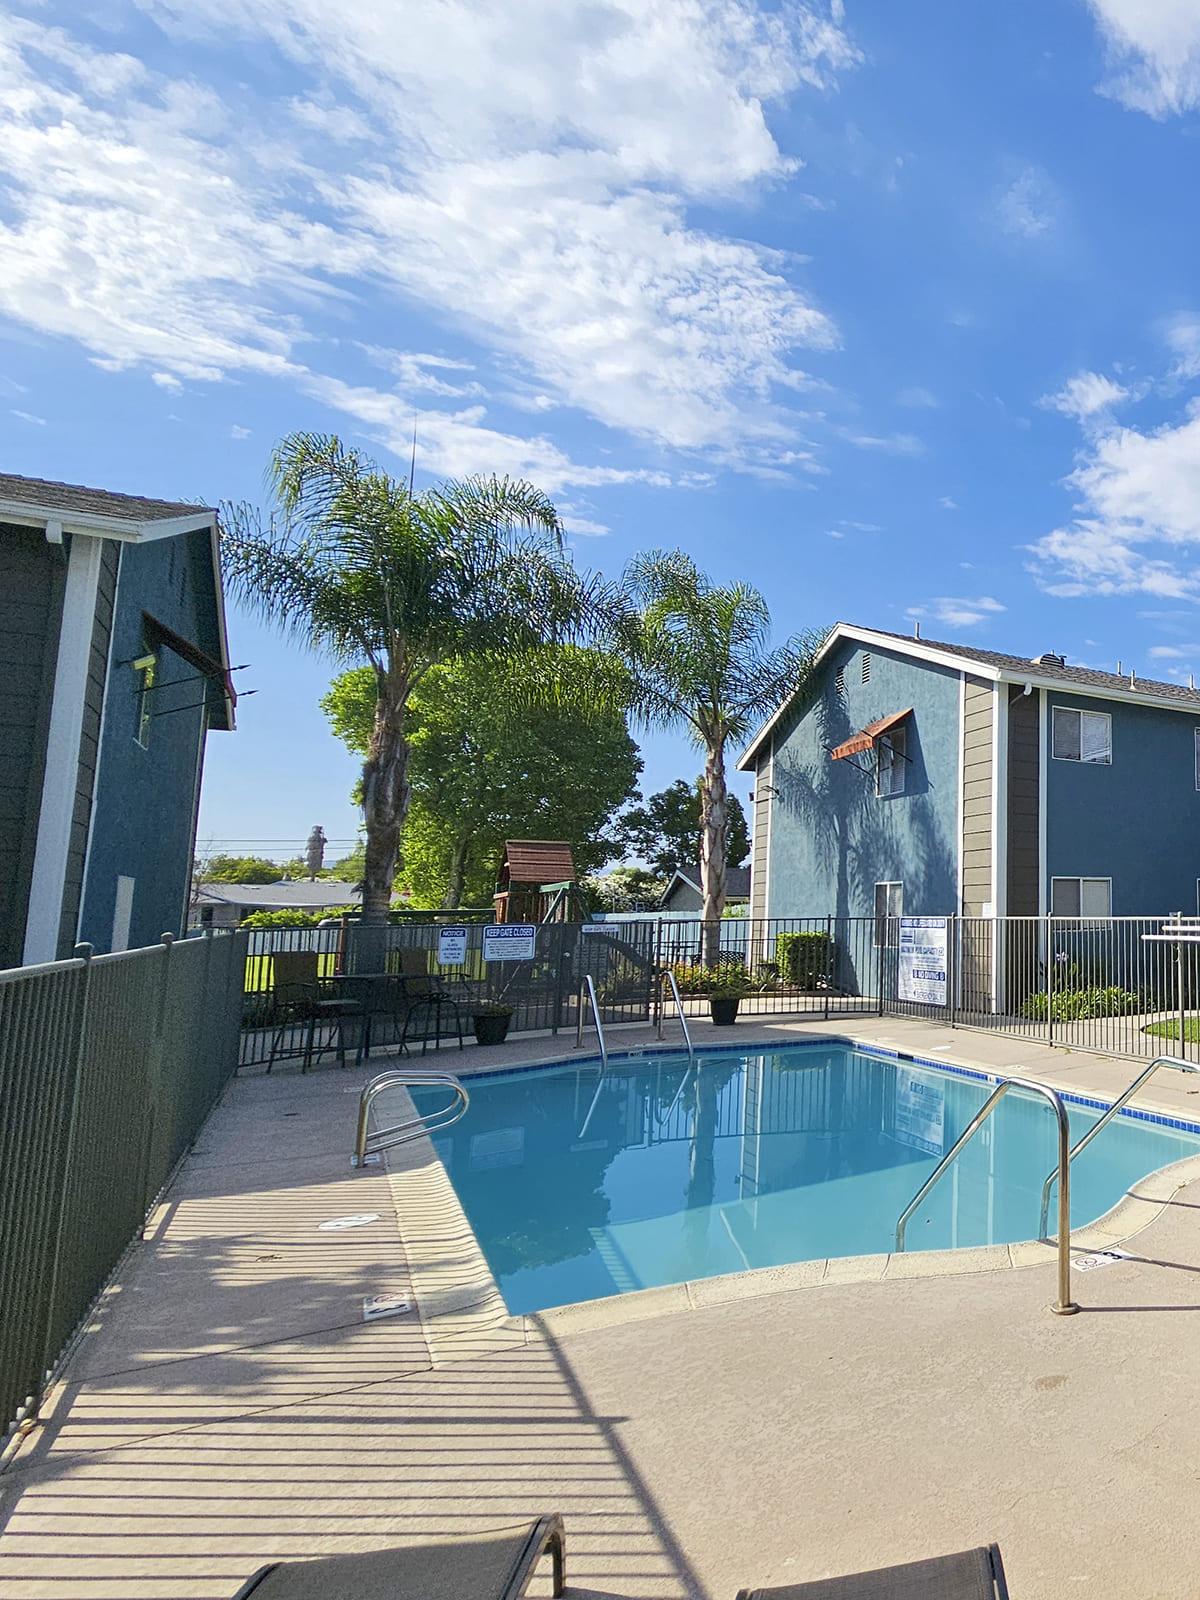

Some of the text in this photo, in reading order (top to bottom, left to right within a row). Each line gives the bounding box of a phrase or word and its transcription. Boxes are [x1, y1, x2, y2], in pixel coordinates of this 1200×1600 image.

[487, 928, 533, 937] KEEP GATE CLOSED
